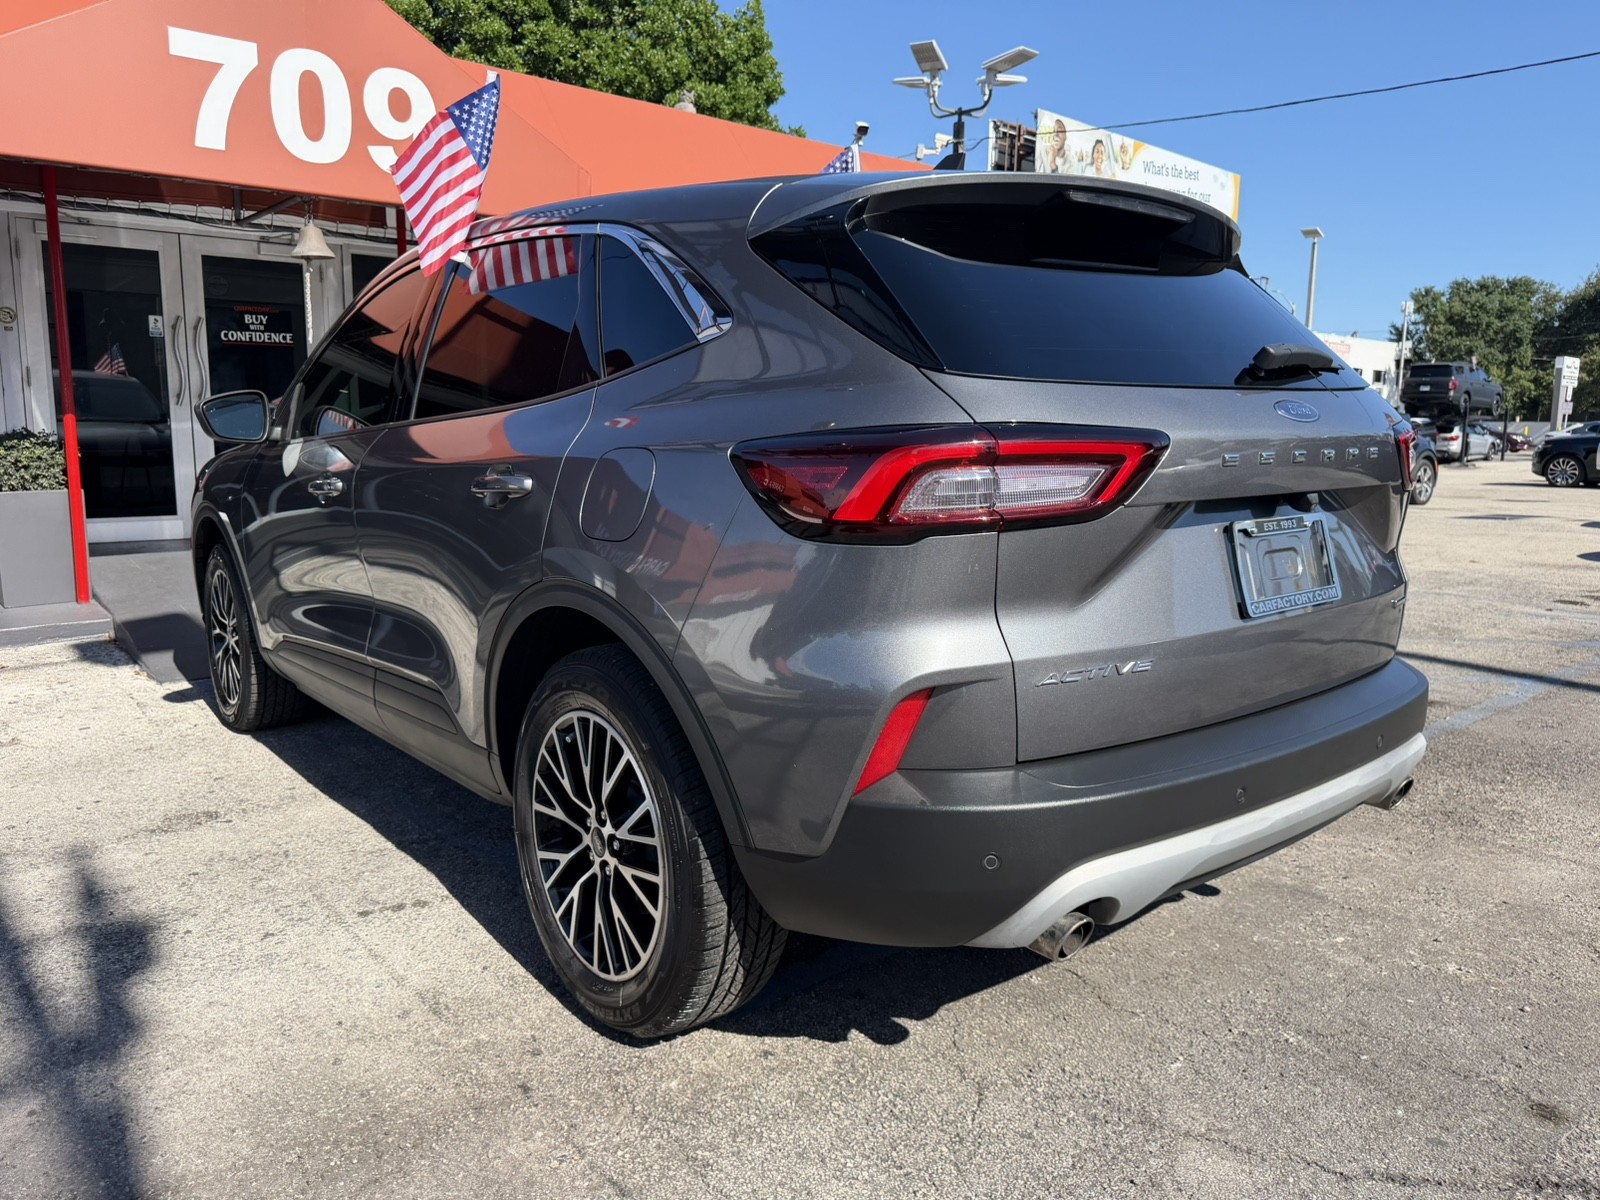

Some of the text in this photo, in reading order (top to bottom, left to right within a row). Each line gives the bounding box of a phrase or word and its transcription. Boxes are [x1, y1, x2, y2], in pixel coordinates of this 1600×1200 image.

[167, 25, 437, 175] 709
[1143, 160, 1200, 181] What's the best
[244, 314, 268, 325] BUY
[220, 330, 294, 343] CONFIDENCE
[1263, 519, 1297, 531] EST. 1993
[1251, 586, 1338, 614] CARFACTORY.COM
[1035, 658, 1155, 688] ACTIVE
